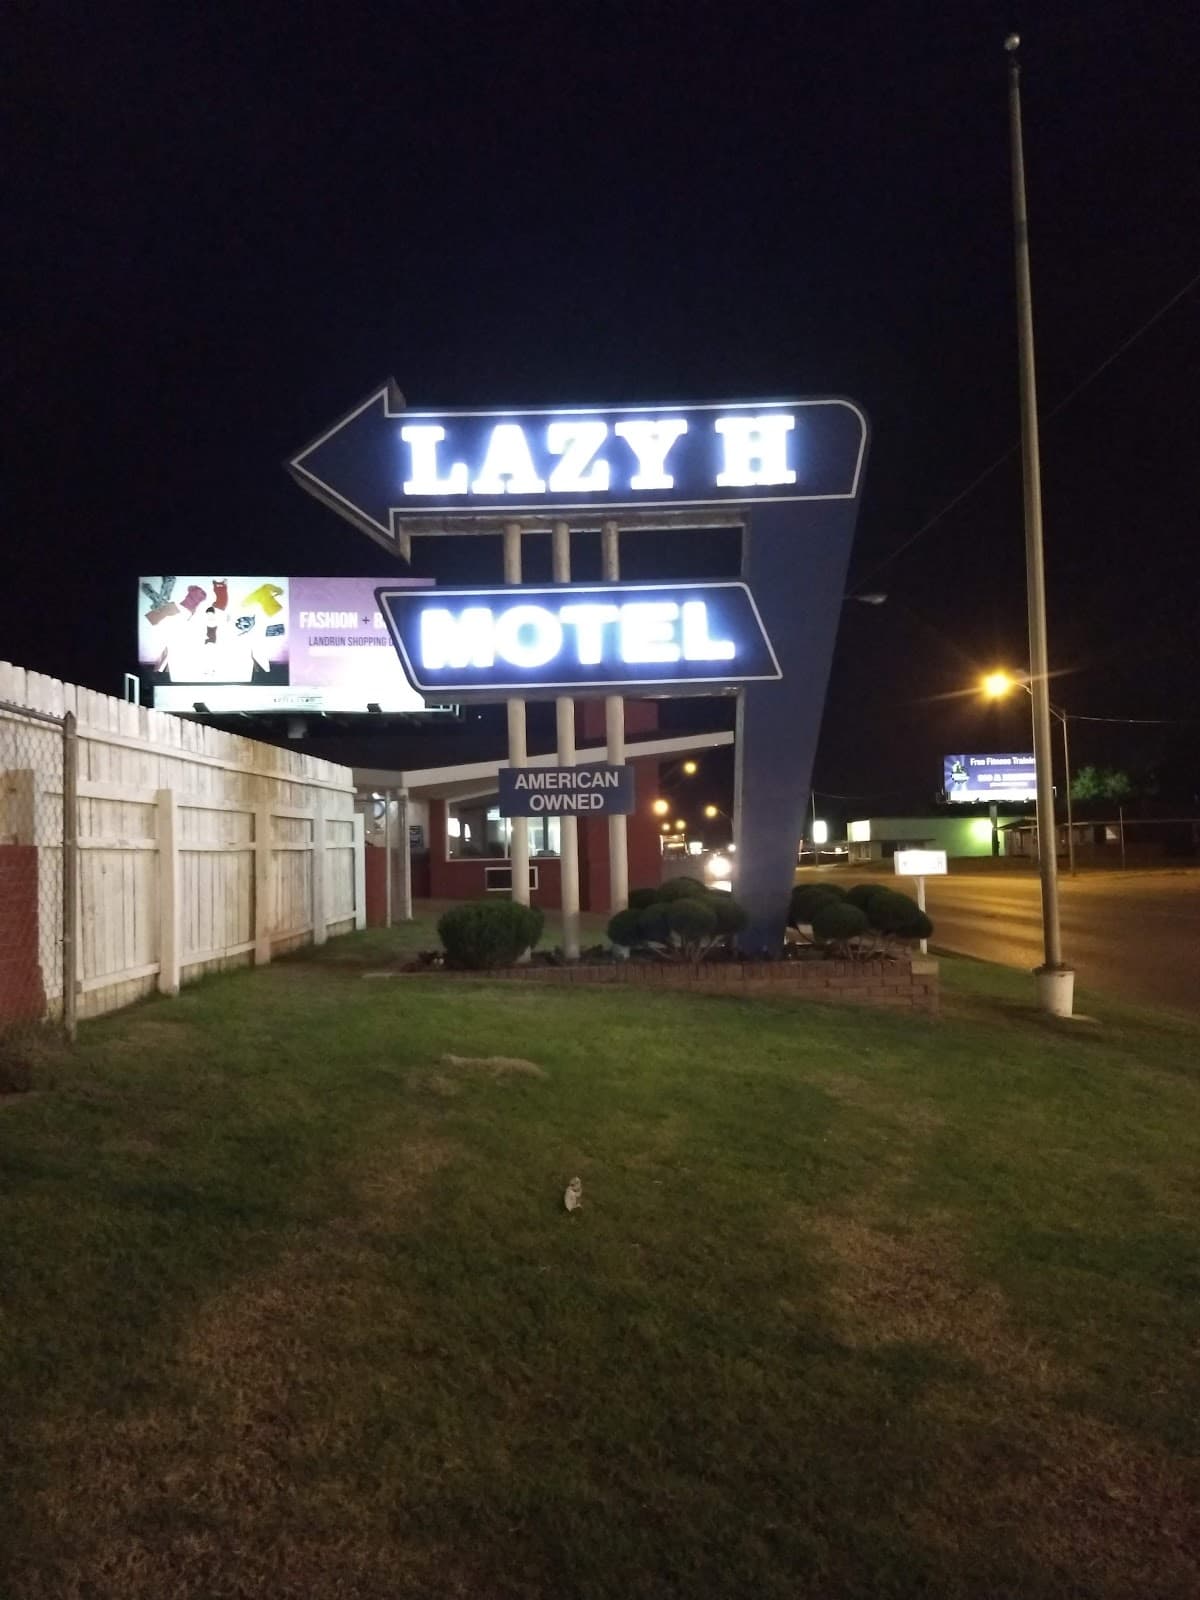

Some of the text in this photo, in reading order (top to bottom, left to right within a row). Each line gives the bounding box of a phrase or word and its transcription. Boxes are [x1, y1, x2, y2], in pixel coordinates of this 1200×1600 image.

[401, 415, 797, 496] LAZY H
[299, 611, 358, 629] FASHION
[308, 636, 346, 647] LANDRUN
[347, 636, 387, 647] SHOPPING
[420, 600, 736, 670] MOTEL
[514, 771, 619, 790] AMERICAN
[529, 793, 605, 811] OWNED
